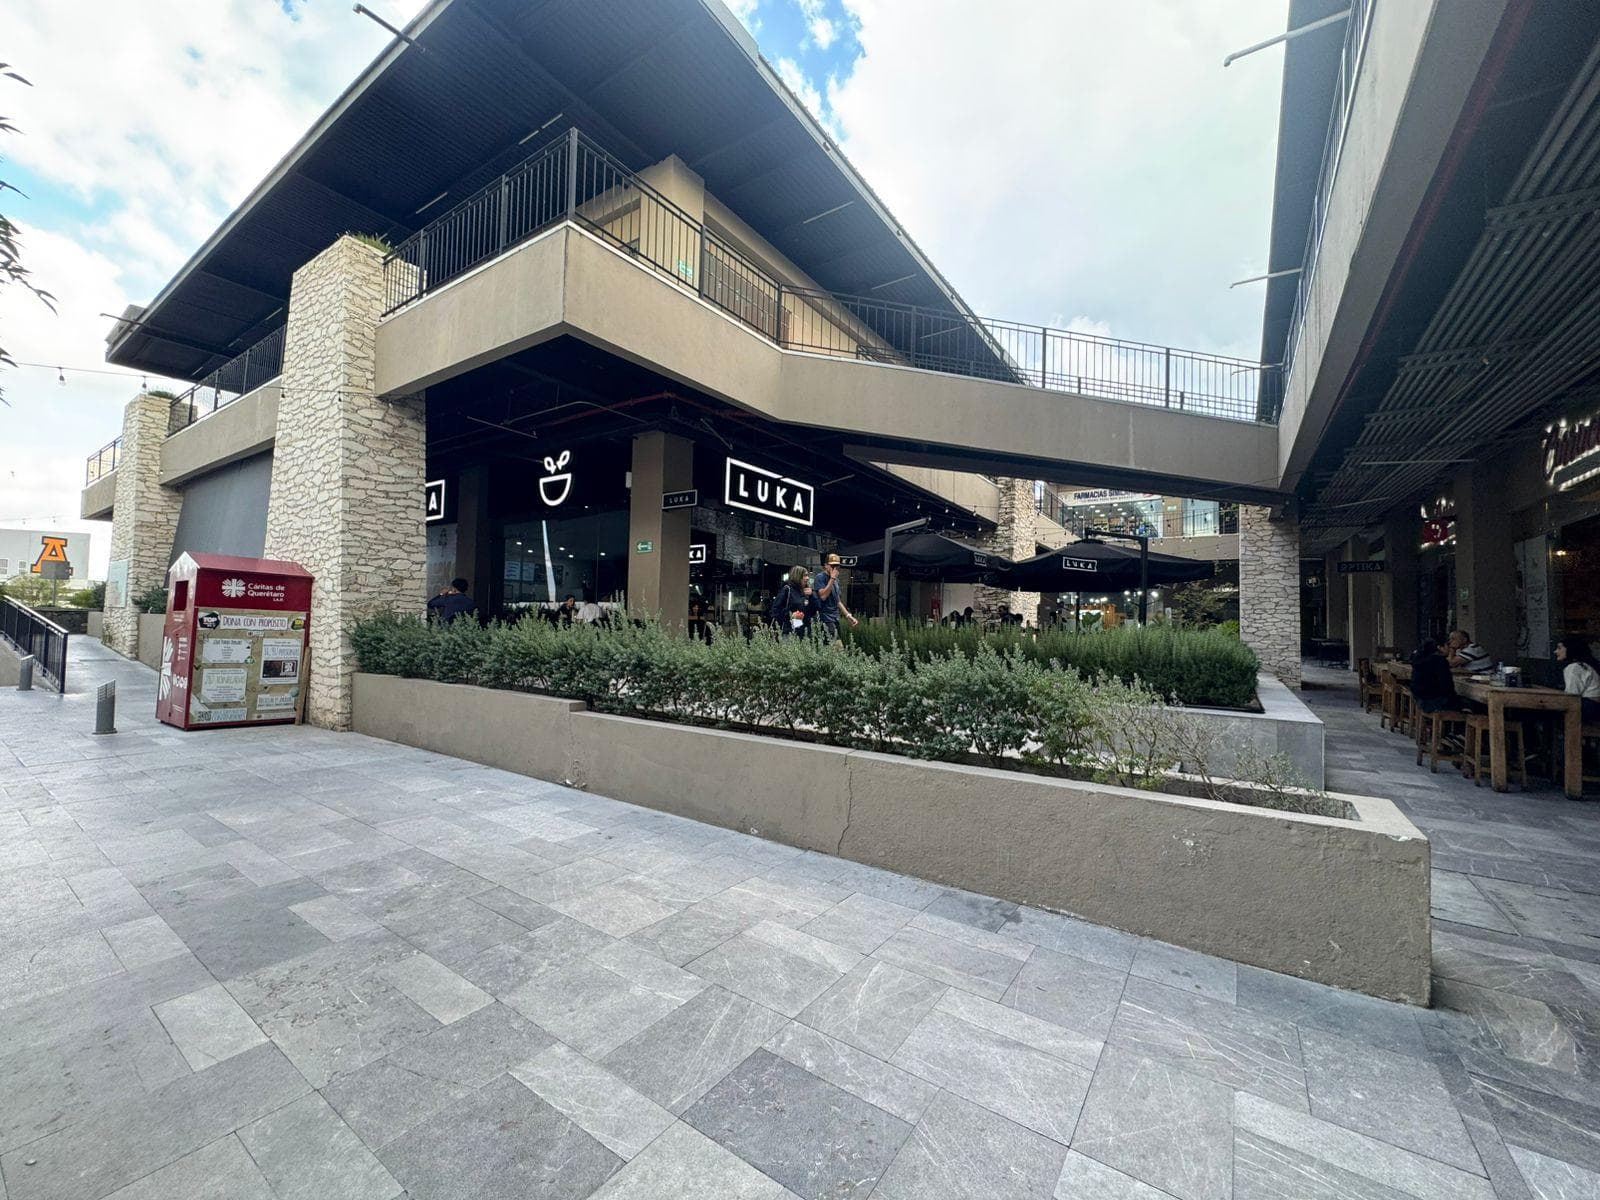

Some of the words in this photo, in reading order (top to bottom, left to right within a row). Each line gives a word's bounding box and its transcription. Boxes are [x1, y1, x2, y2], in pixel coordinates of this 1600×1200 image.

[738, 473, 804, 514] LUKA
[1073, 490, 1107, 500] FARMACIAS
[668, 495, 689, 504] LUKA
[1066, 559, 1094, 570] LUKA
[247, 582, 274, 591] Cáritas
[247, 589, 285, 598] Querétaro
